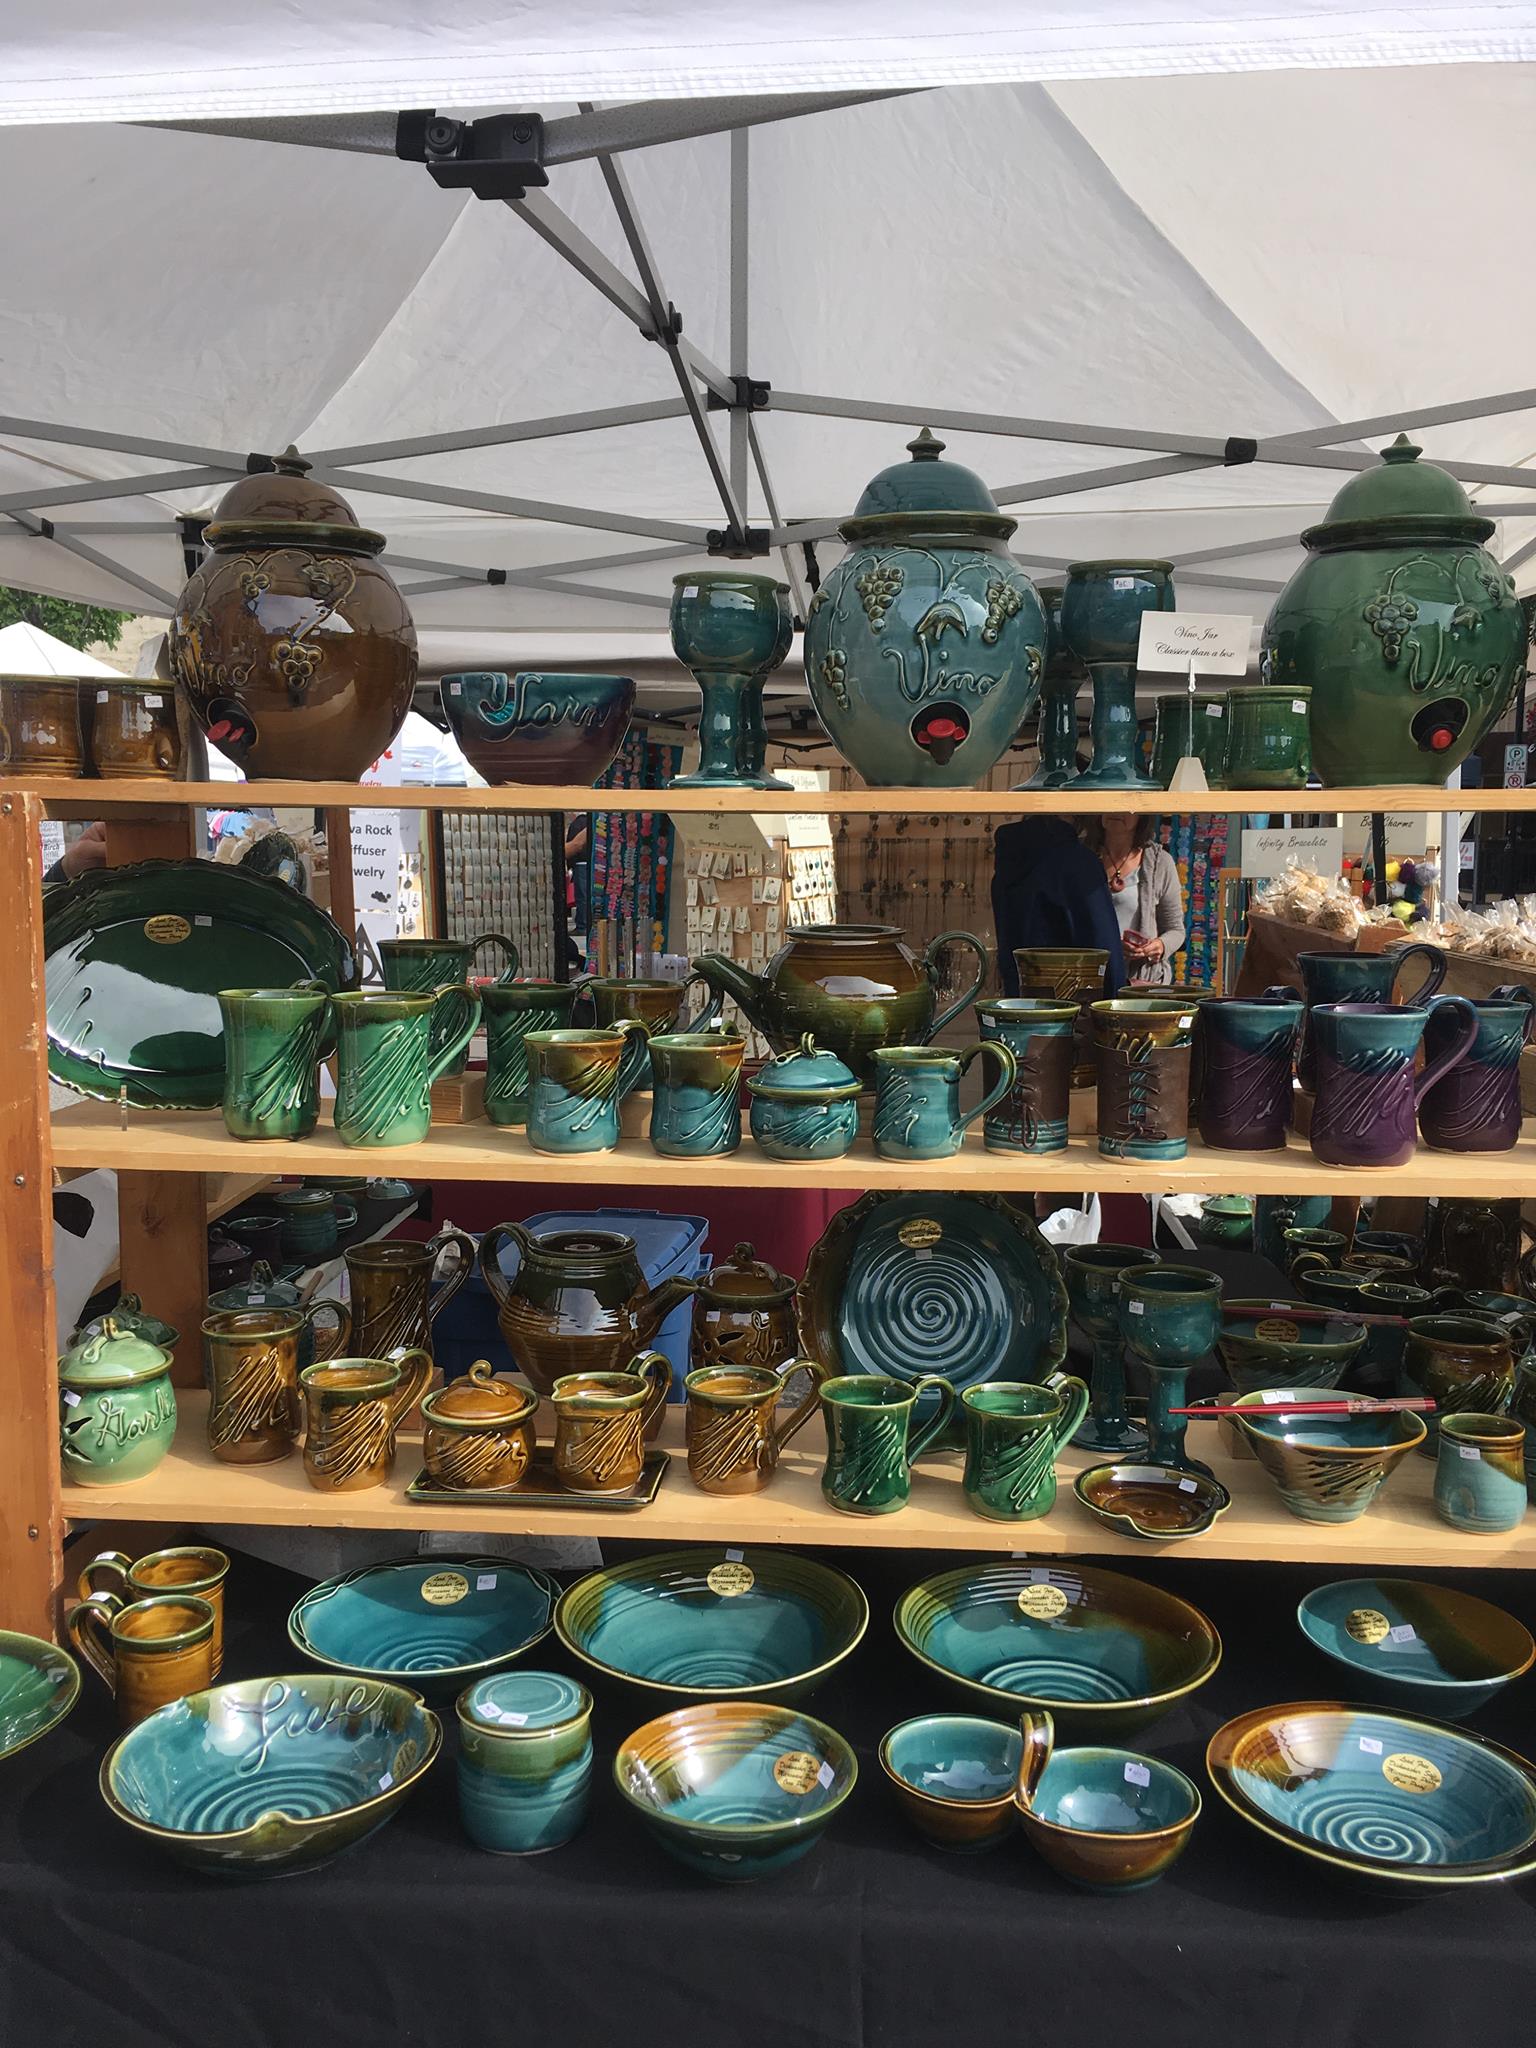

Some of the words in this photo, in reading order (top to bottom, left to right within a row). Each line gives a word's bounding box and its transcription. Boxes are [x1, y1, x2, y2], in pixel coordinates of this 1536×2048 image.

[1174, 625, 1197, 639] Vino
[1197, 627, 1219, 640] Jar
[1155, 642, 1189, 656] Classier
[1190, 647, 1210, 657] than
[1219, 649, 1235, 658] box
[882, 635, 1013, 704] Vino
[1407, 634, 1498, 693] Vino
[350, 825, 361, 834] va
[365, 824, 392, 836] Rock
[352, 844, 387, 856] ffuser
[1256, 836, 1285, 851] Infinity
[1287, 836, 1328, 848] Bracelets
[353, 866, 385, 880] welry
